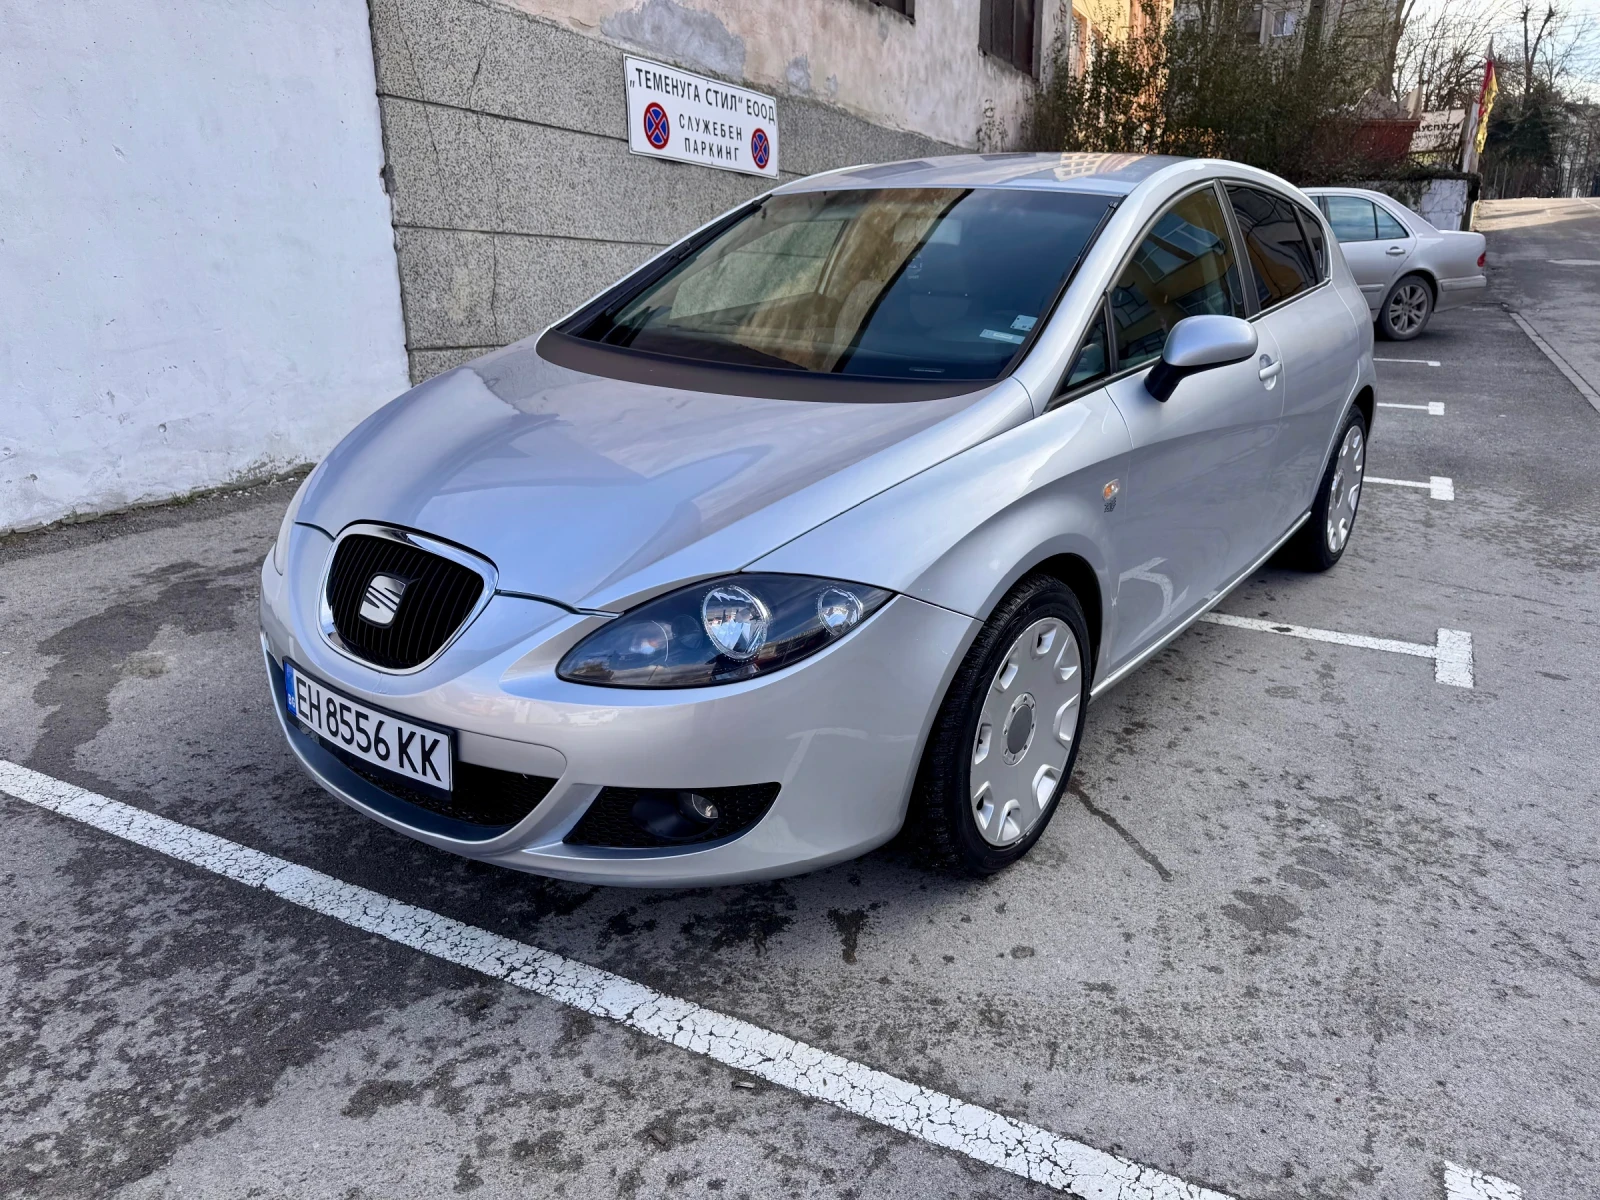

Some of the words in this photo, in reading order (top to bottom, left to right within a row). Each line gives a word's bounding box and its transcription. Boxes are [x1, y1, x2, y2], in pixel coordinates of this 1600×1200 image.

[746, 99, 775, 126] ЕООД
[679, 114, 742, 141] СЛУЖЕБЕН
[684, 138, 739, 161] ПАРКИНГ
[326, 697, 391, 762] 8556
